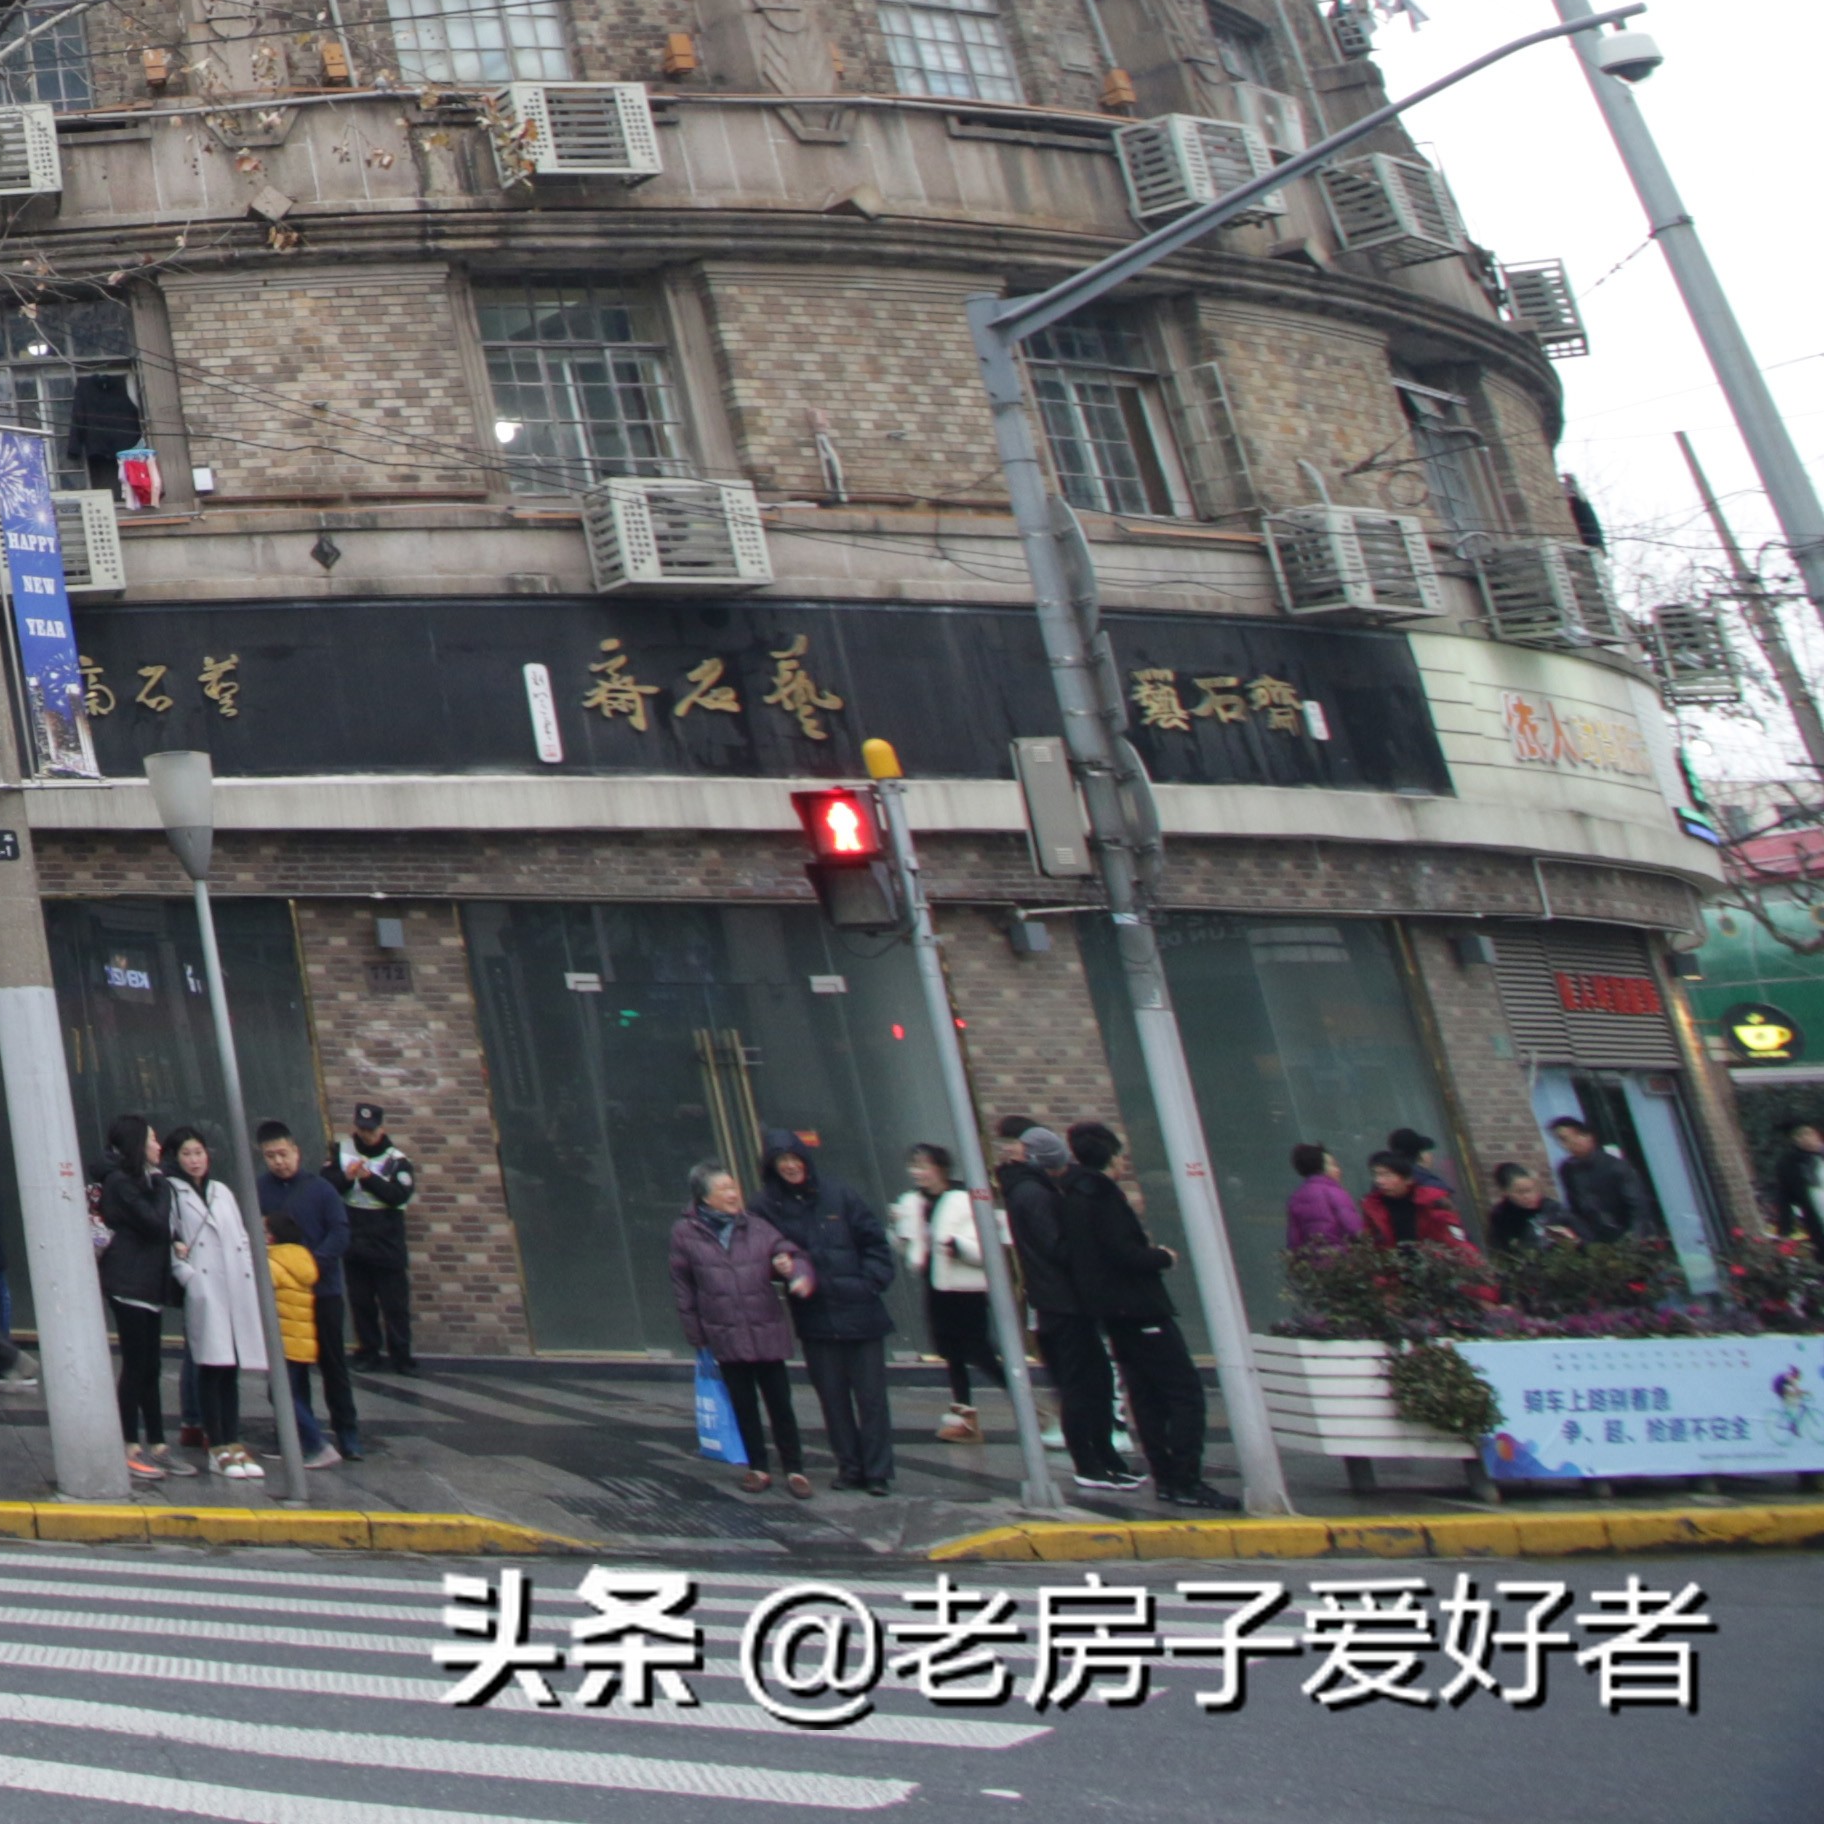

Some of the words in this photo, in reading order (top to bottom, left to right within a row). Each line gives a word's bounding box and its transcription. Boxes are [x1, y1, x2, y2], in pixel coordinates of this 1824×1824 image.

[7, 532, 56, 554] HAPPY
[22, 575, 56, 595] NEW
[25, 618, 67, 639] YEAR
